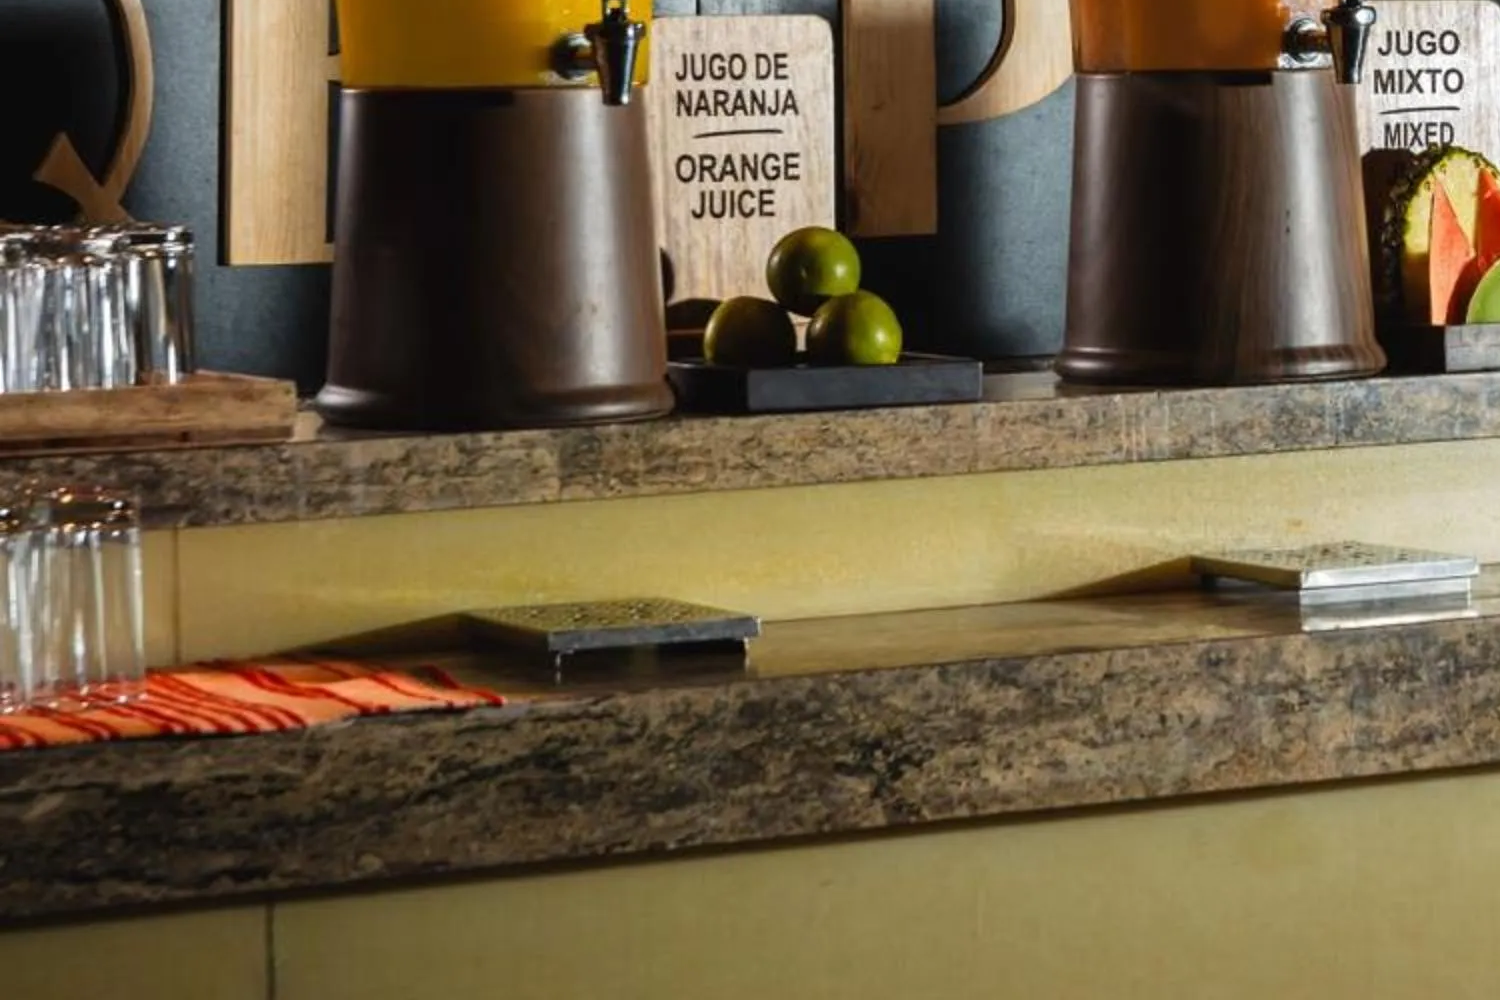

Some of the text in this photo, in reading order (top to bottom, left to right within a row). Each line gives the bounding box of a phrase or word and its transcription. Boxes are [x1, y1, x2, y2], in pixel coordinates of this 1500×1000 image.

[1377, 30, 1460, 56] JUGO
[675, 53, 789, 82] JUGO DE
[1374, 68, 1464, 94] MIXTO
[676, 89, 799, 117] NARANJA
[675, 152, 801, 184] ORANGE
[691, 189, 776, 219] JUICE
